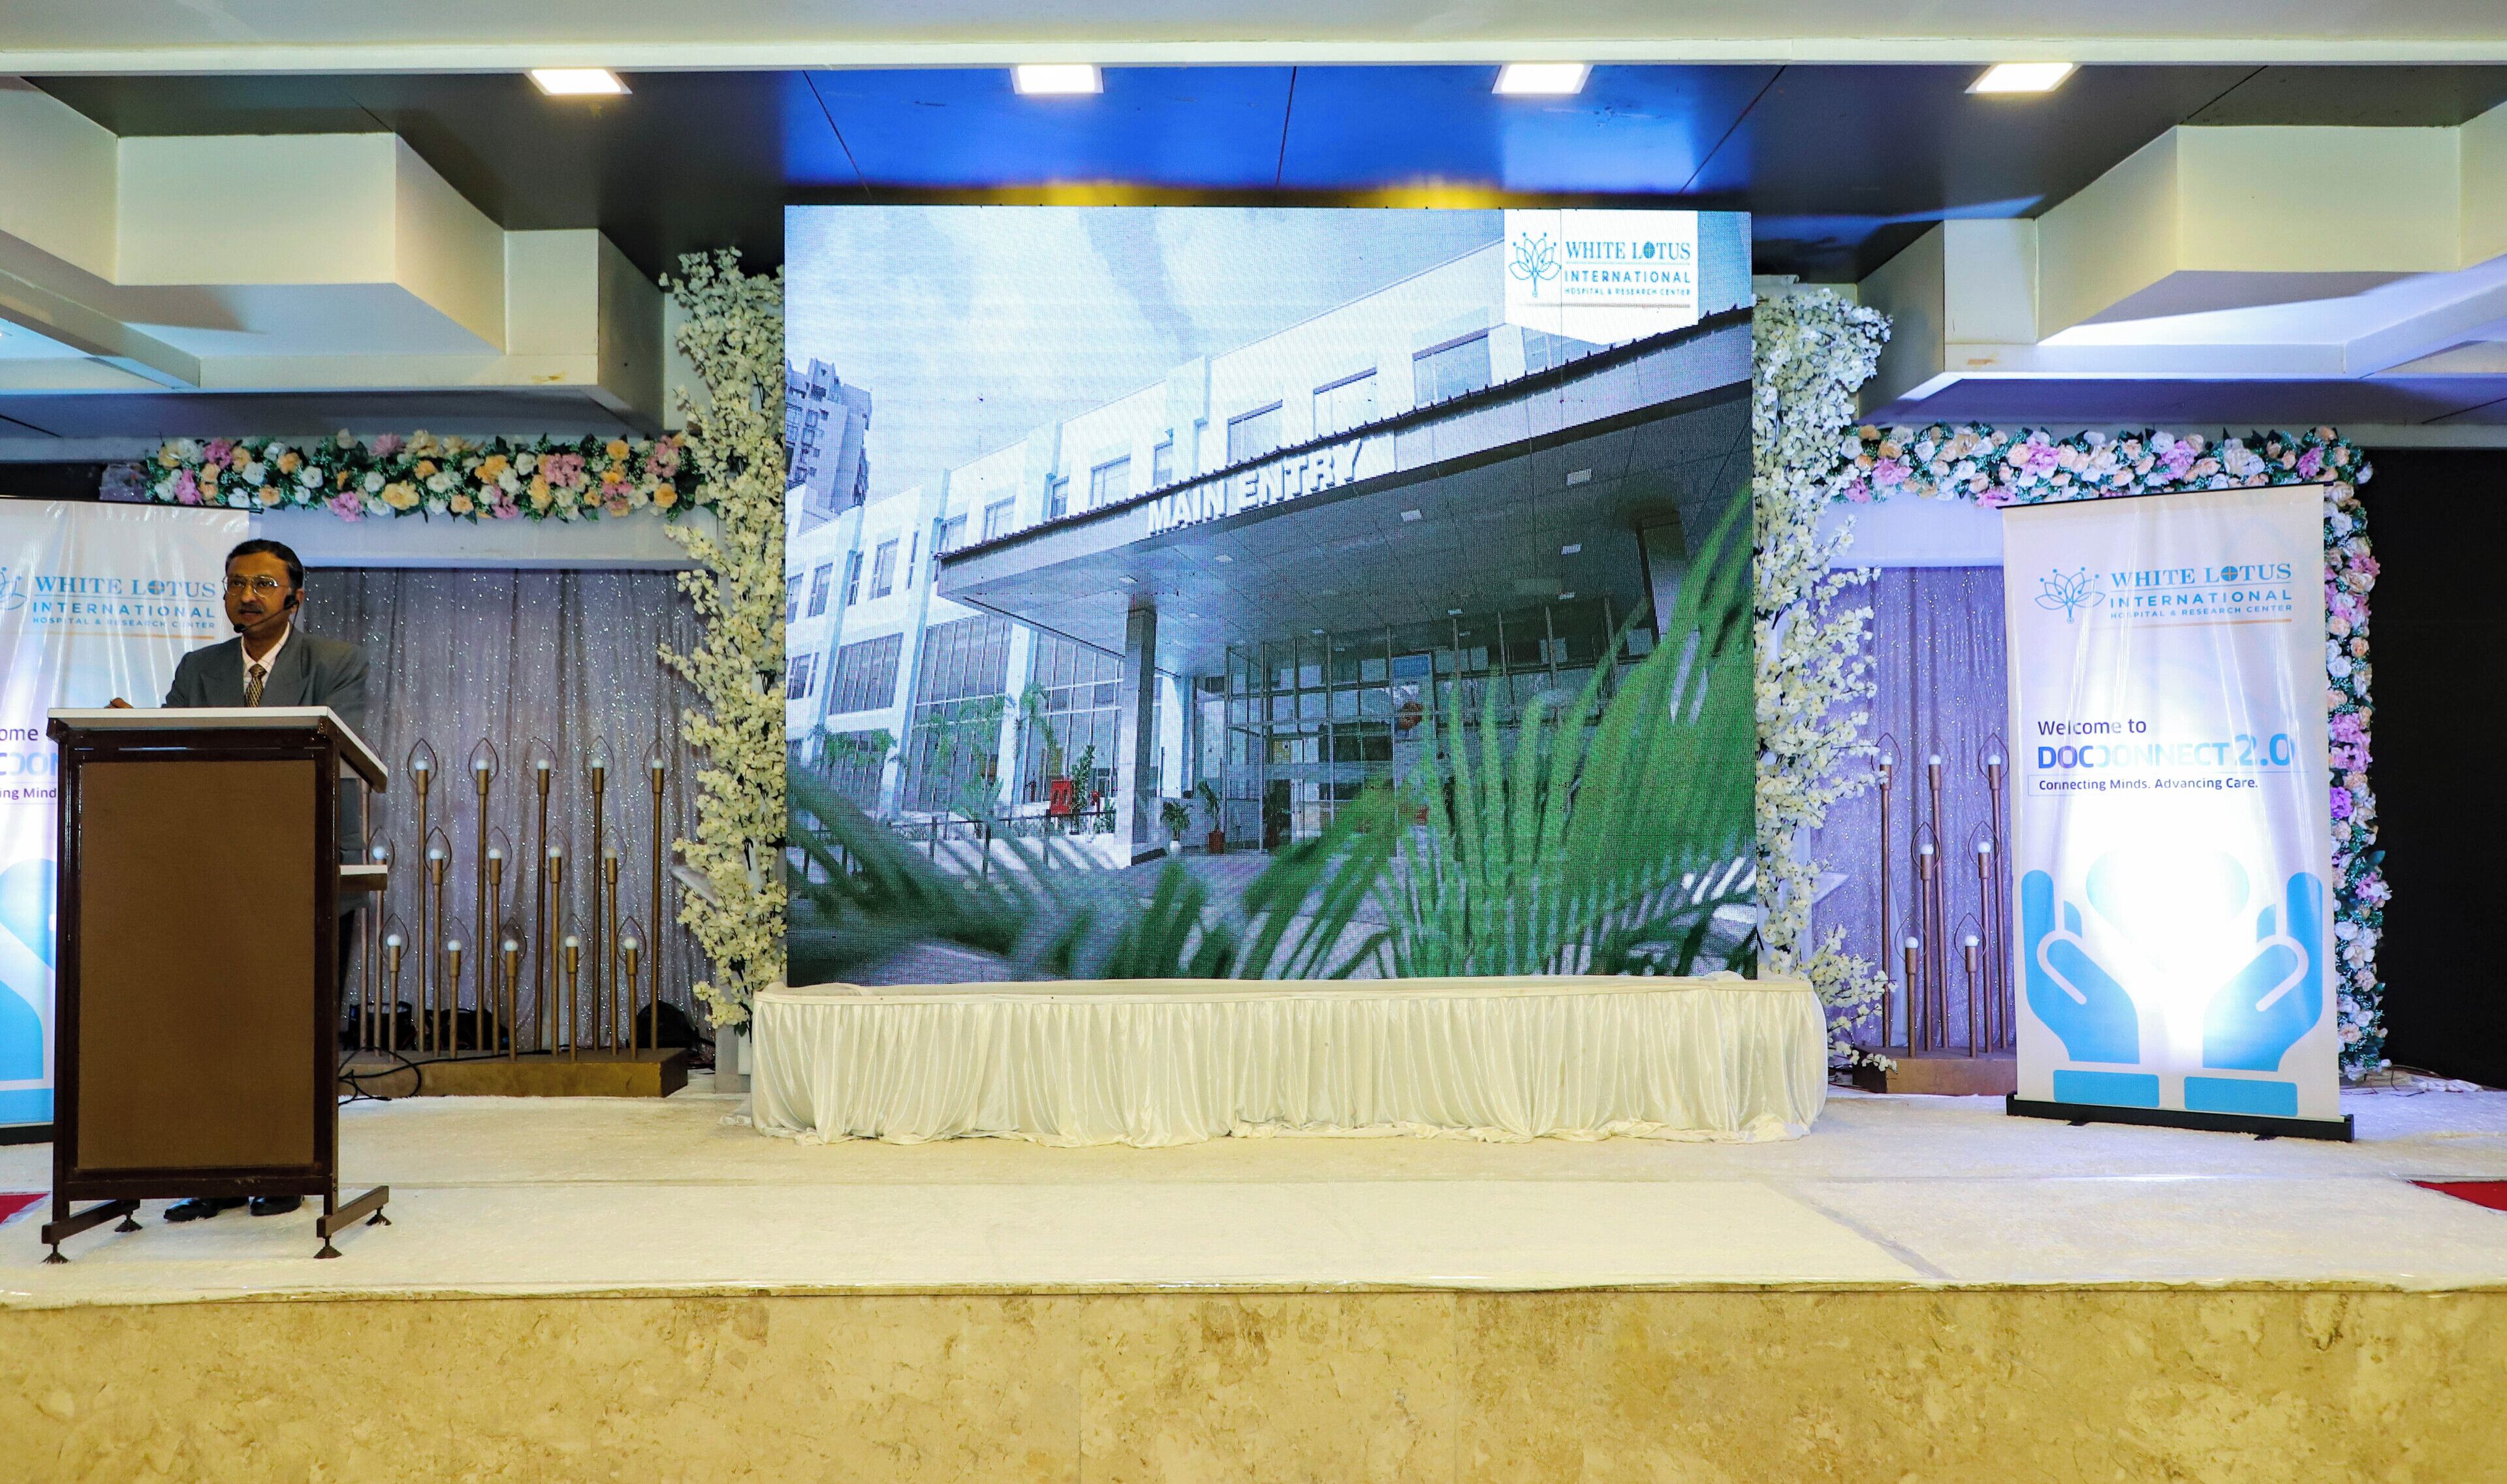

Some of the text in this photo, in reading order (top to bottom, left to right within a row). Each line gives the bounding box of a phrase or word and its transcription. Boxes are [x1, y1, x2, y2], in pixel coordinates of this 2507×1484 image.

[1566, 240, 1691, 260] WHITE LOTUS
[1564, 270, 1691, 283] INTERNATIONAL
[1565, 287, 1604, 296] HOSPITAL
[1615, 287, 1657, 296] RESEARCH
[1148, 437, 1364, 536] MAIN ENTRY
[2111, 563, 2292, 588] WHITE LOTUS
[34, 576, 216, 598] WHITE LOTUS
[2110, 589, 2292, 608] INTERNATIONAL
[33, 602, 215, 618] INTERNATIONAL
[2181, 607, 2241, 616] RESEARCH
[2246, 604, 2292, 613] CENTER
[2037, 718, 2147, 736] Welcome to
[2039, 778, 2258, 791] Connecting Minds. Advancing Care.
